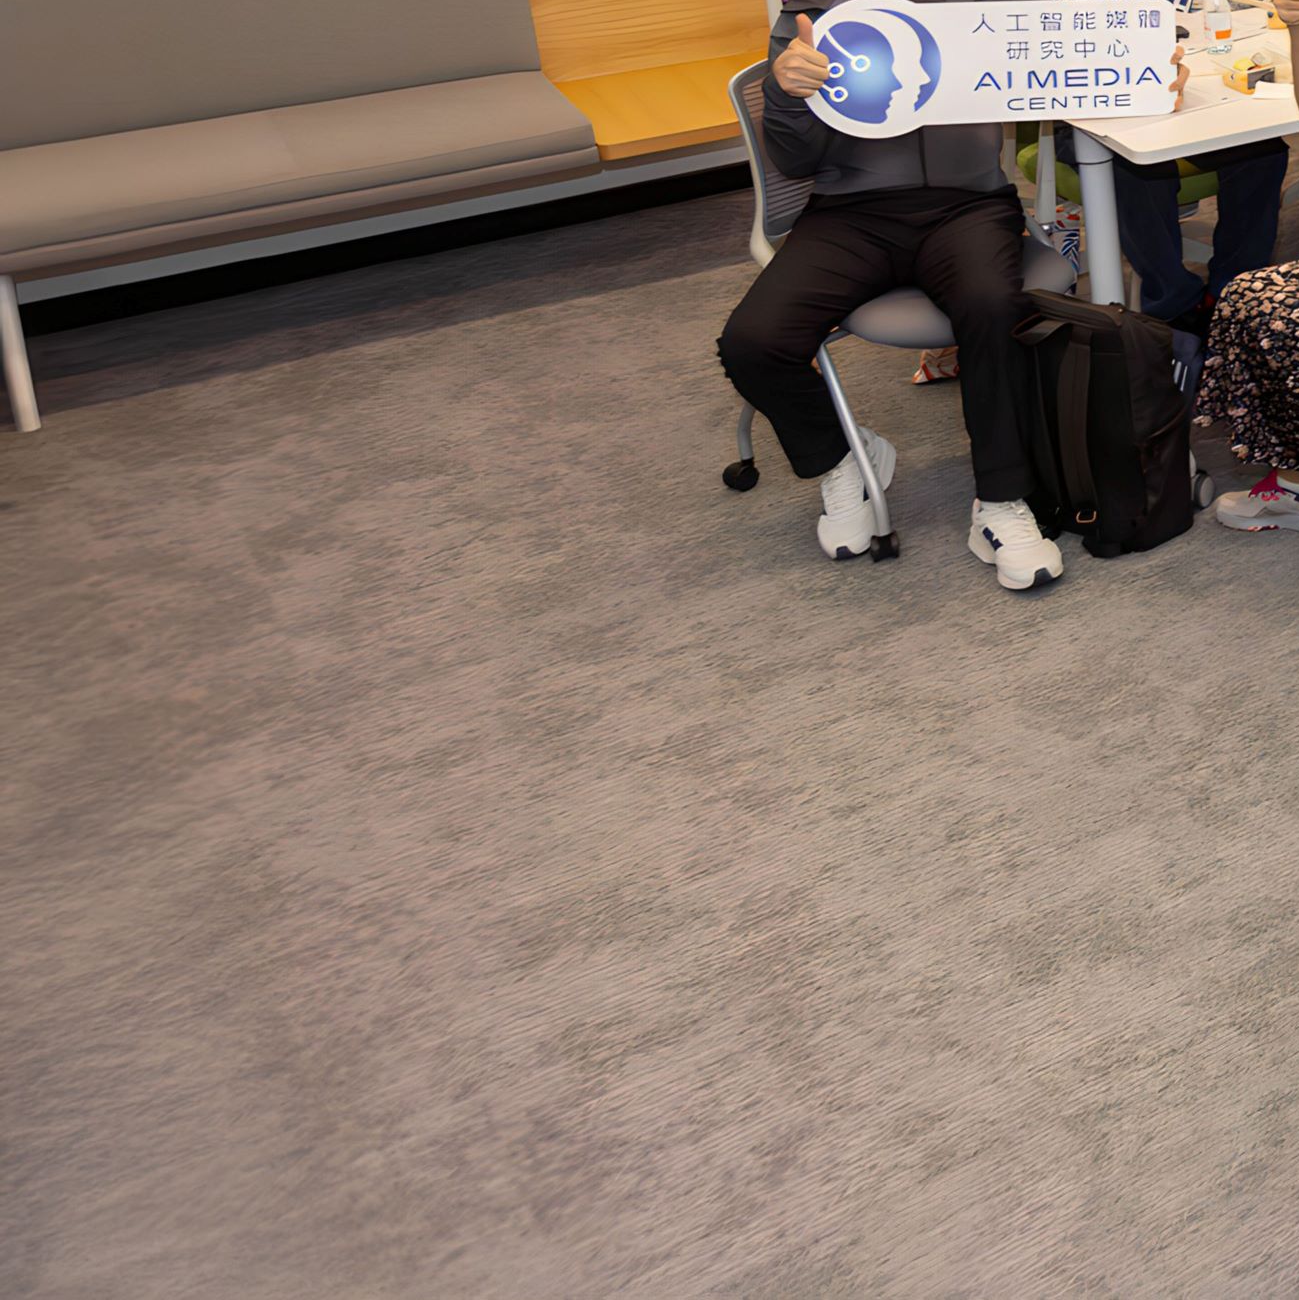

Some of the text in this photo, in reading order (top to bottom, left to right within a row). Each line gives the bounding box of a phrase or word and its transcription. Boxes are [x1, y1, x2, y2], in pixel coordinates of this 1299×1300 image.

[972, 9, 1161, 34] 人工智能媒體
[1006, 38, 1130, 61] 研究中心
[974, 66, 1162, 92] AI MEDIA
[1007, 93, 1132, 111] CENTRE
